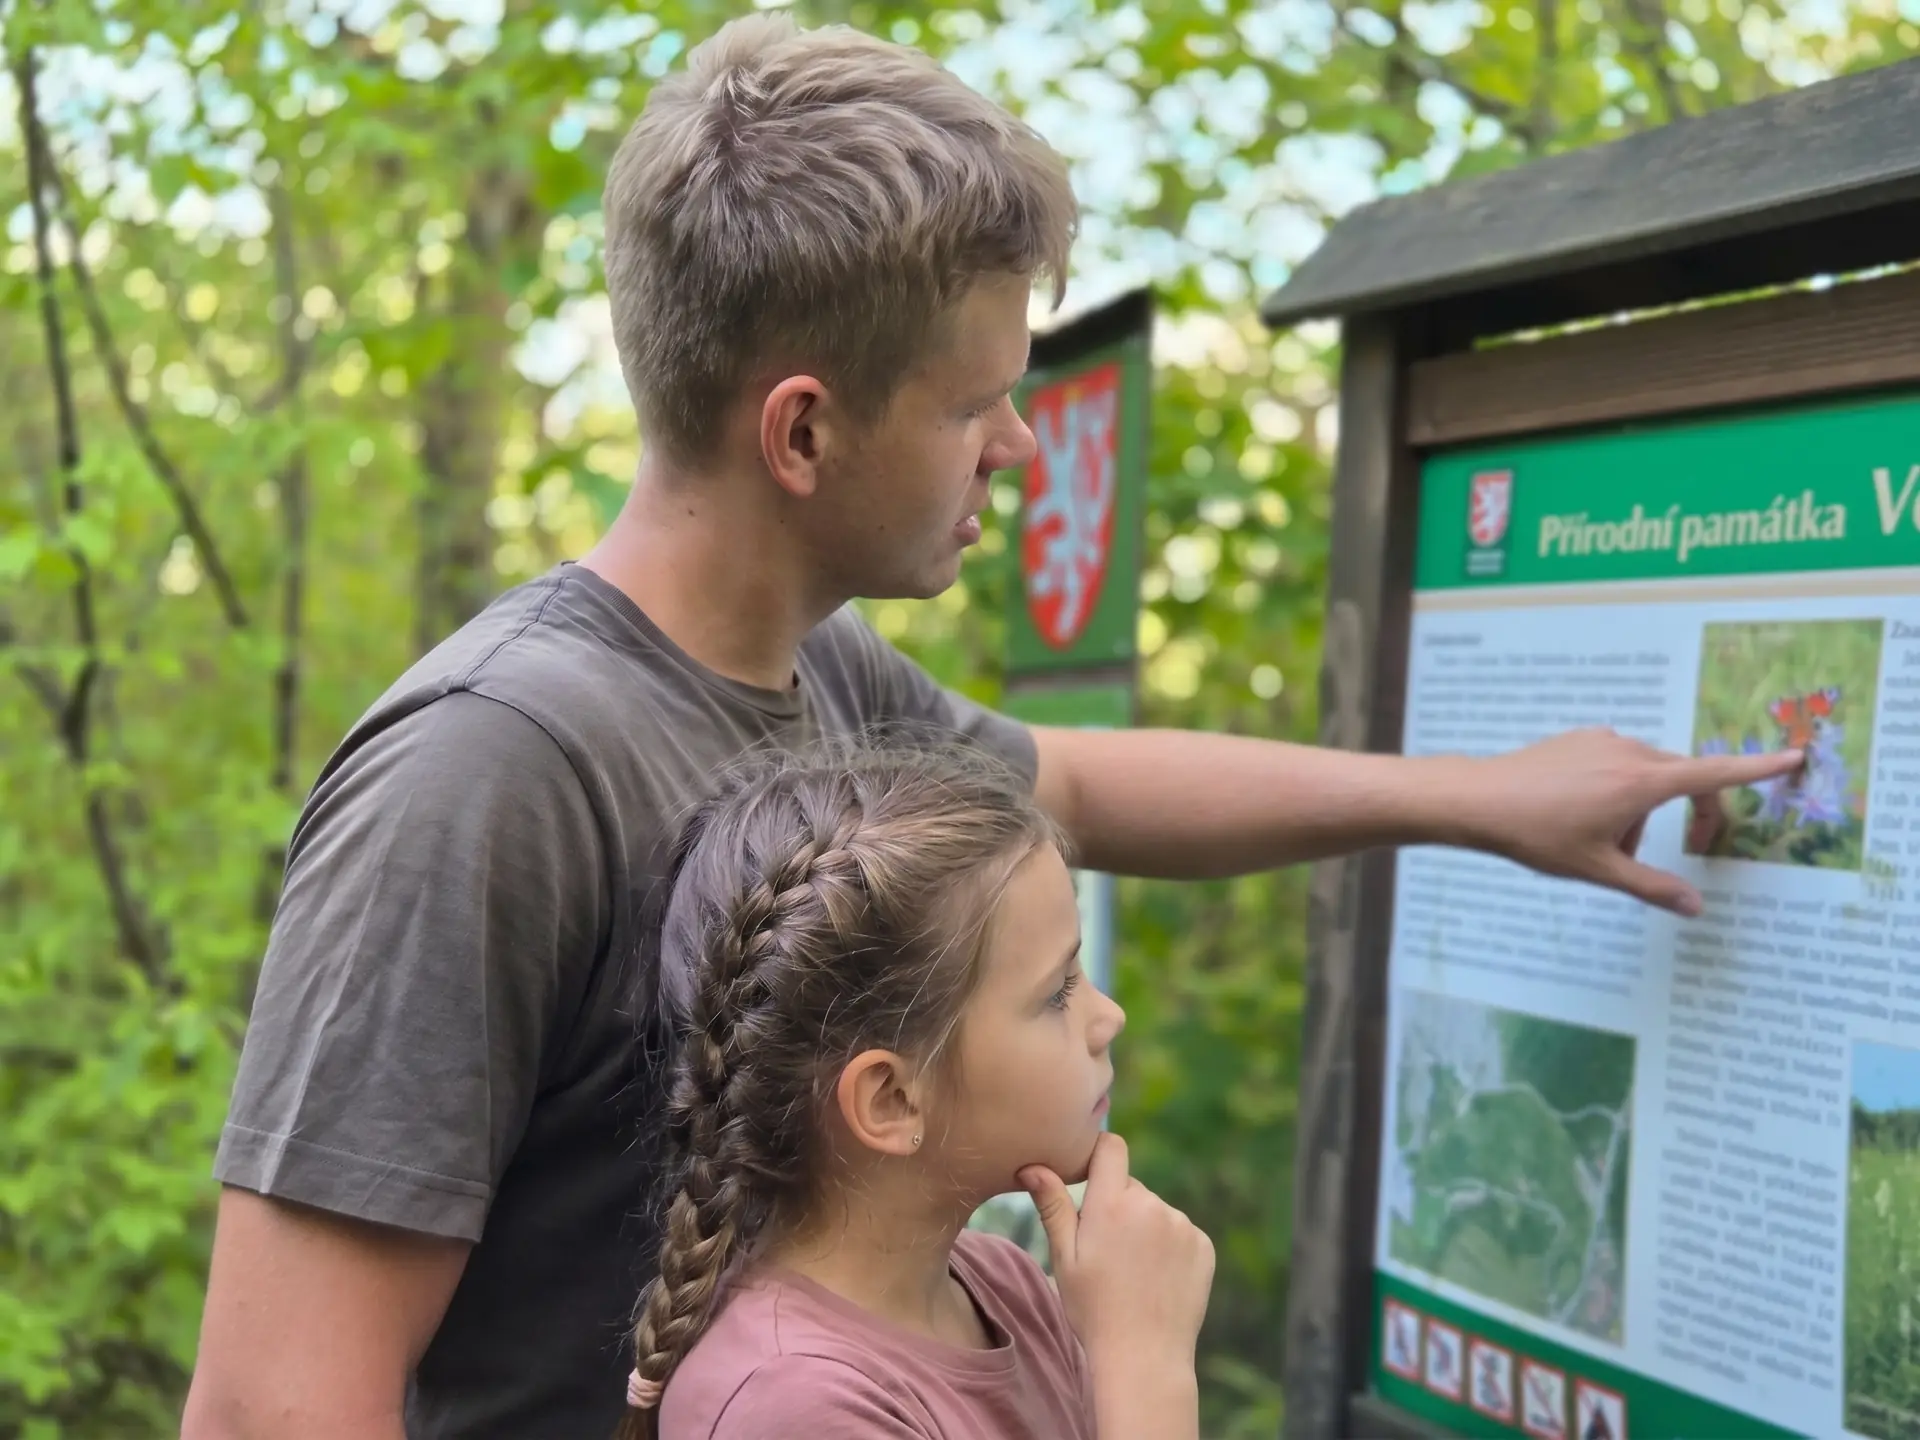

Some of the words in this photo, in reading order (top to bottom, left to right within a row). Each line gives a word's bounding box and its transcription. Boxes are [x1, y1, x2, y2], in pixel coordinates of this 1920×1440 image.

[1538, 503, 1681, 558] Přírodní
[1676, 488, 1846, 563] památka
[1872, 464, 1920, 536] V
